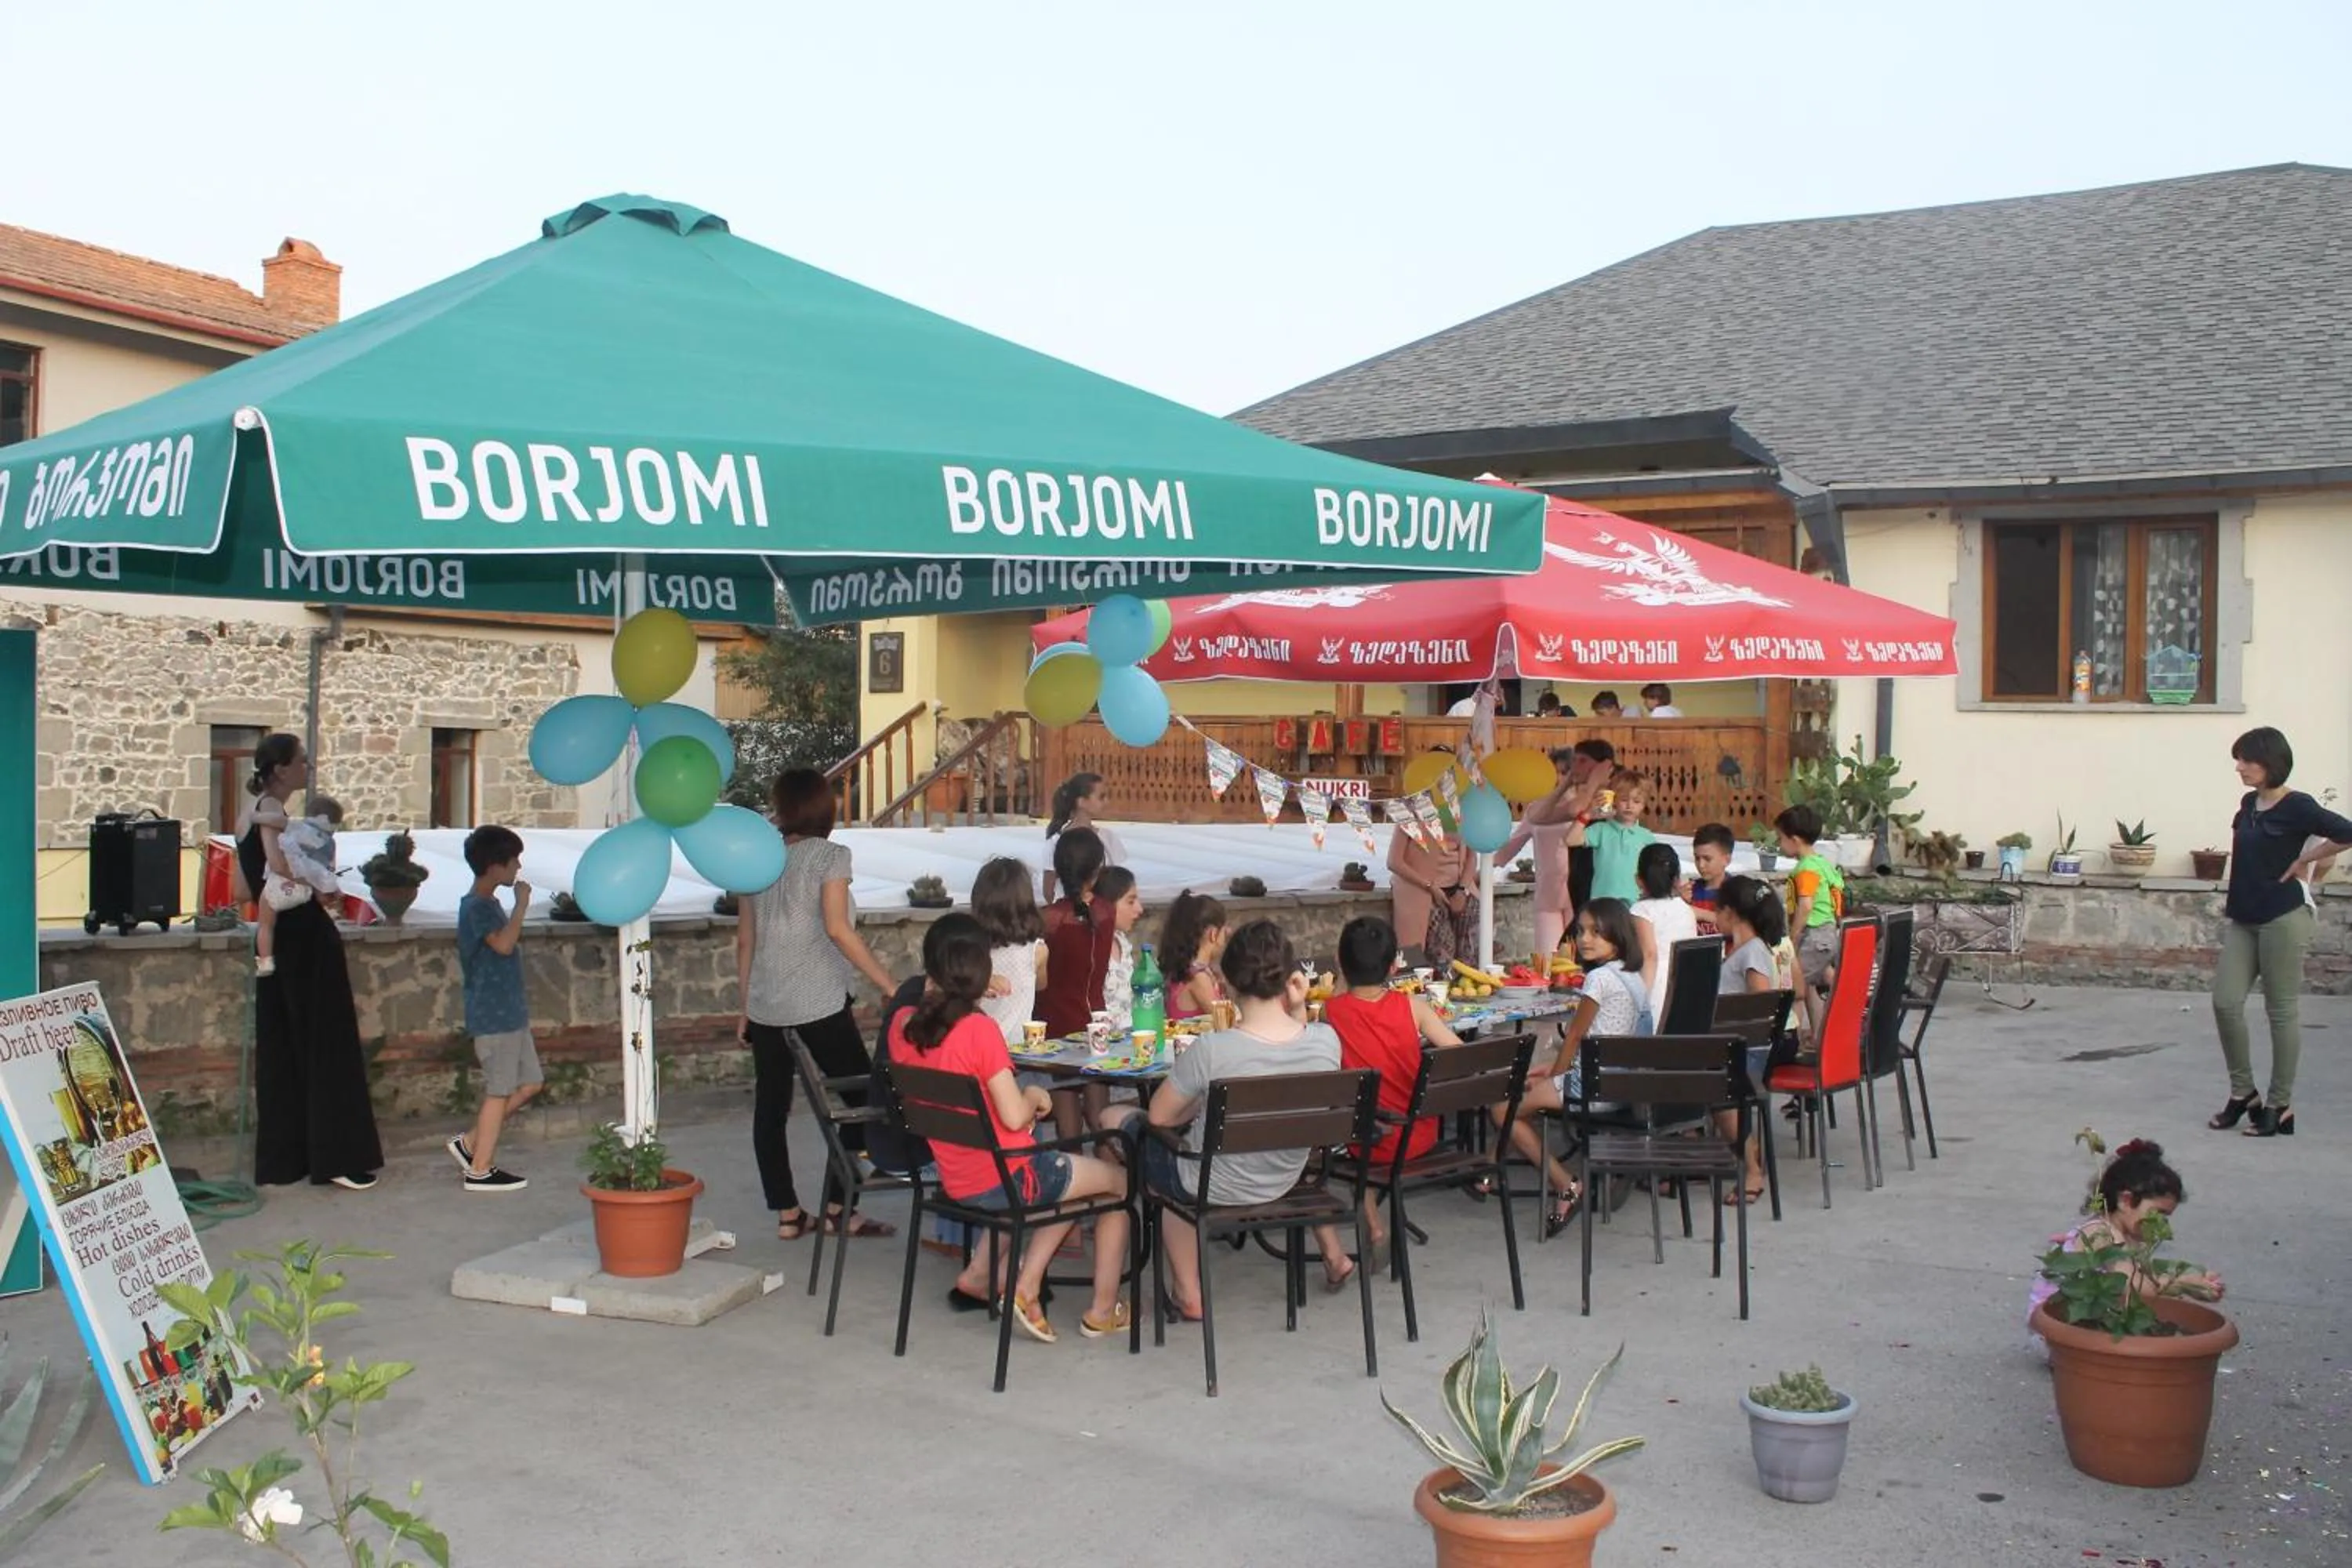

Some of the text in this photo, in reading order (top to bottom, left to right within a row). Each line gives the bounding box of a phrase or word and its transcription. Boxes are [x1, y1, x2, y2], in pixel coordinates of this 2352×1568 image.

[24, 434, 194, 530] ბორჯომი
[405, 437, 768, 528] BORJOMI
[942, 466, 1194, 539] BORJOMI
[1314, 488, 1492, 552] BORJOMI
[1200, 635, 1290, 661] ზედაზენი
[1349, 639, 1471, 665] ზედაზენი
[1571, 639, 1679, 665] ზედაზენი
[1730, 636, 1825, 662] ზედაზენი
[1865, 641, 1944, 662] ზედაზენი
[1305, 782, 1367, 797] NUKRI
[0, 993, 98, 1027] ЗЛИВНОЕ ПИВО
[0, 1022, 78, 1062] Draft beer
[69, 1200, 152, 1247] ГОРЯЧИЕ БЛЮДА
[76, 1218, 161, 1269] Hot dishes
[118, 1245, 201, 1298] Cold drinks
